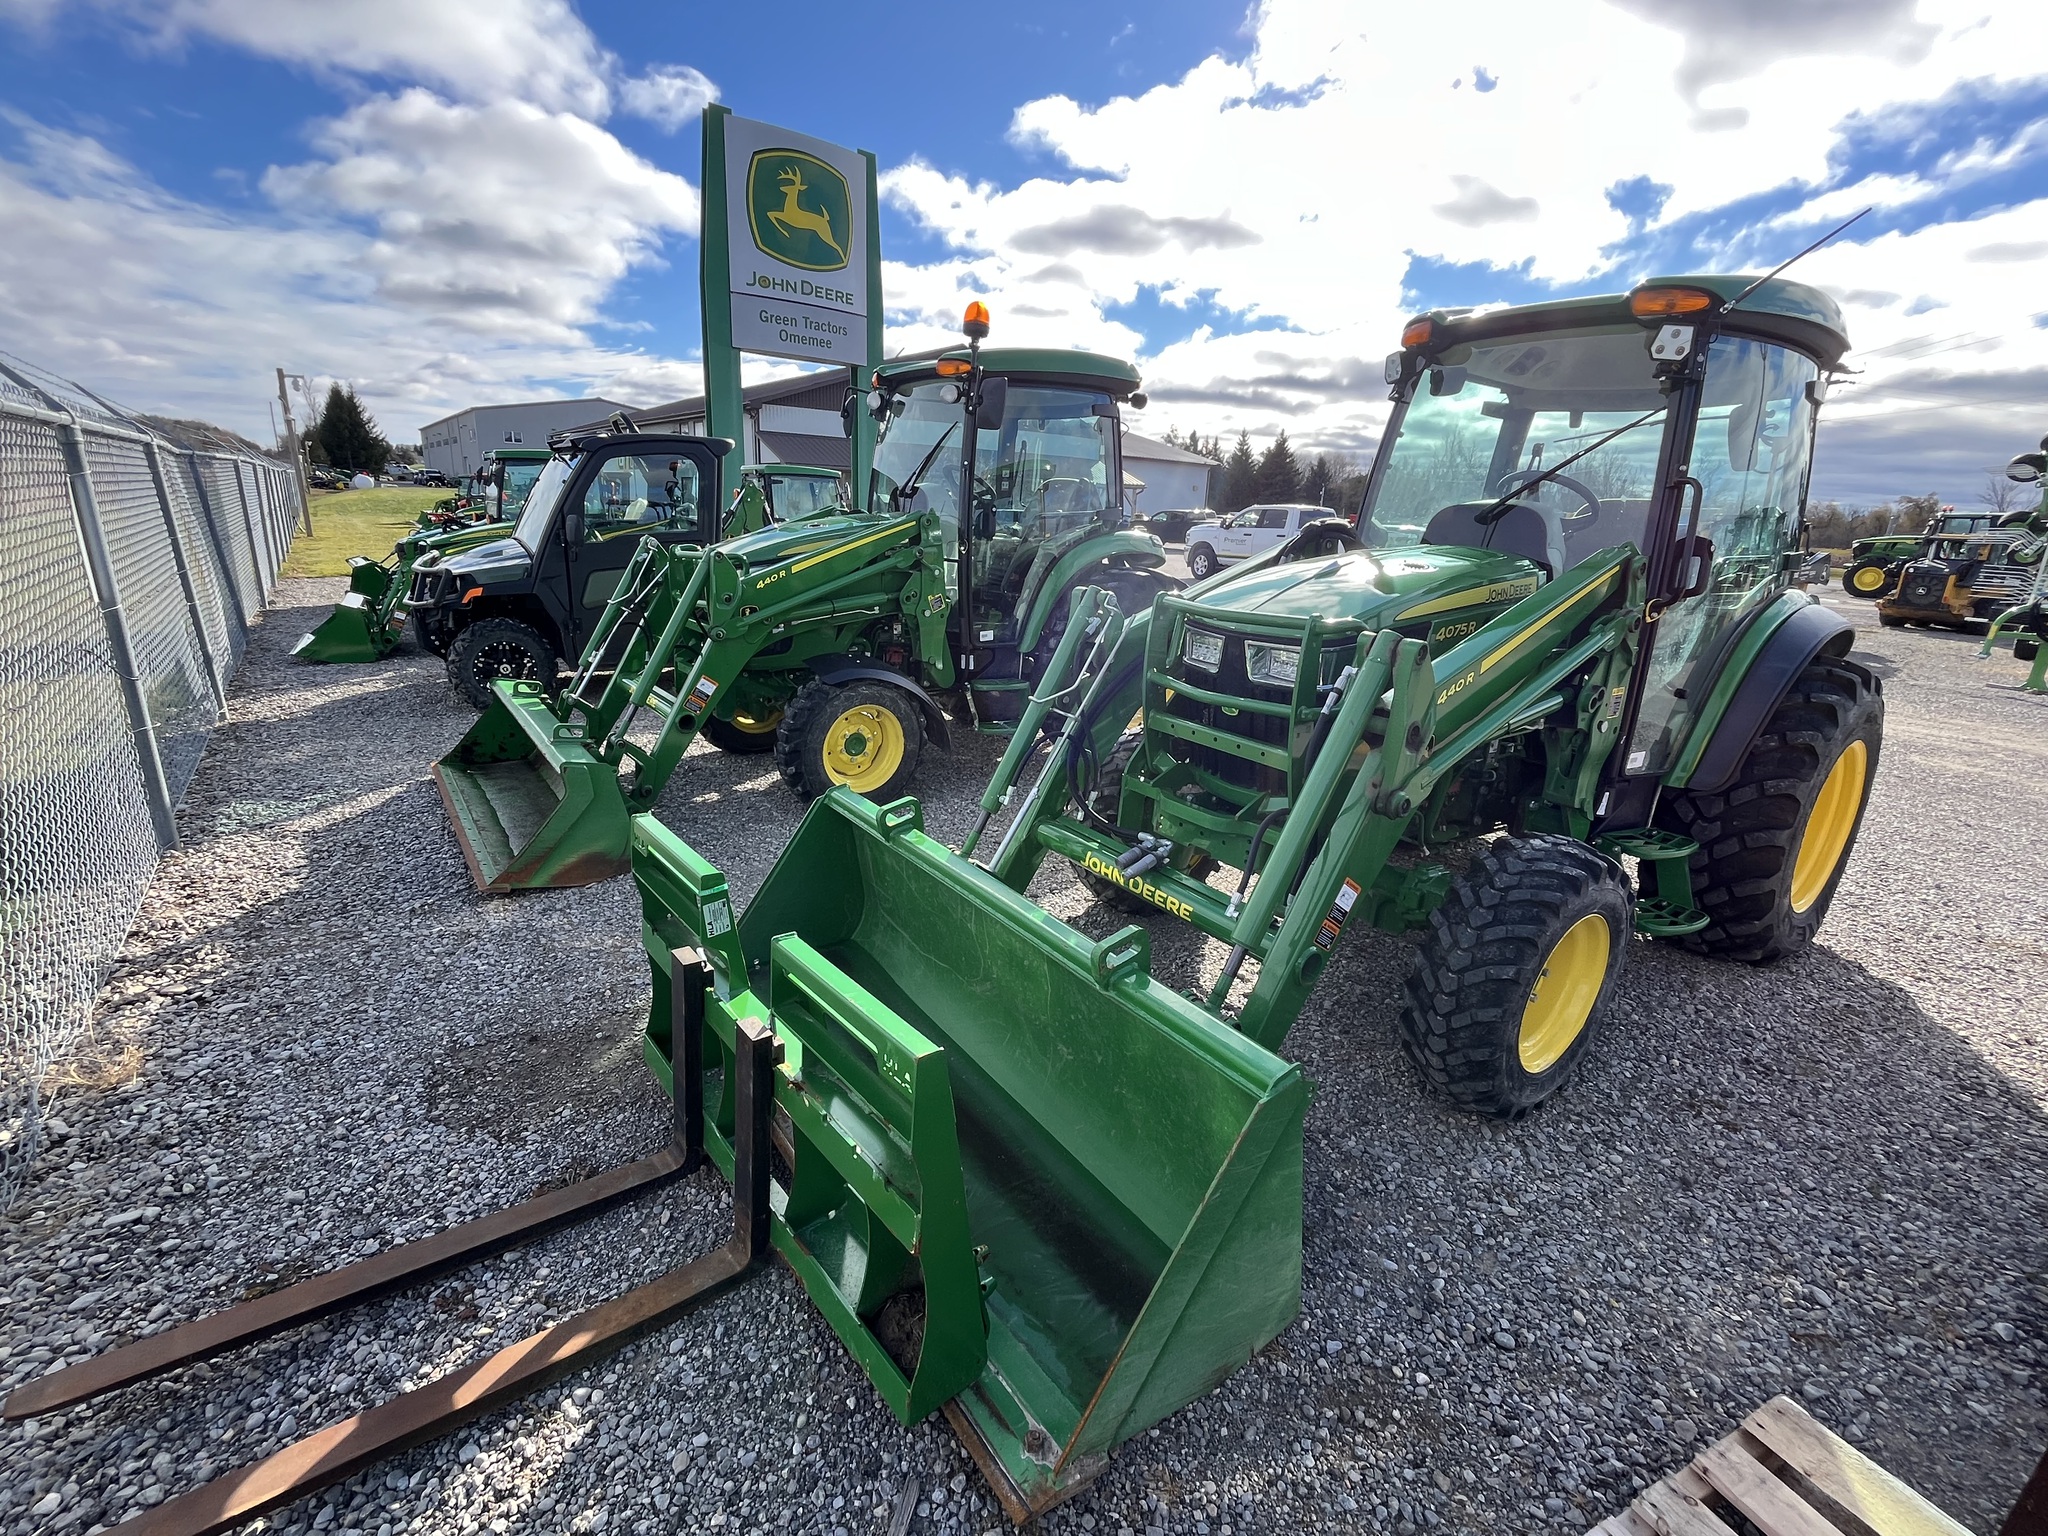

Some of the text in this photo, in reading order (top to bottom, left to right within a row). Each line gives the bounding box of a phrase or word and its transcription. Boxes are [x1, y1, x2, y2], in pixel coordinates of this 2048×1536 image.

[746, 271, 854, 306] JOHN DEERE
[759, 309, 848, 336] Green Tractors
[779, 329, 832, 348] Omemee
[756, 574, 778, 589] 440
[1484, 583, 1532, 603] JOHN DEERE
[1435, 621, 1477, 641] 4075R
[1081, 851, 1194, 922] JOHN DEERE
